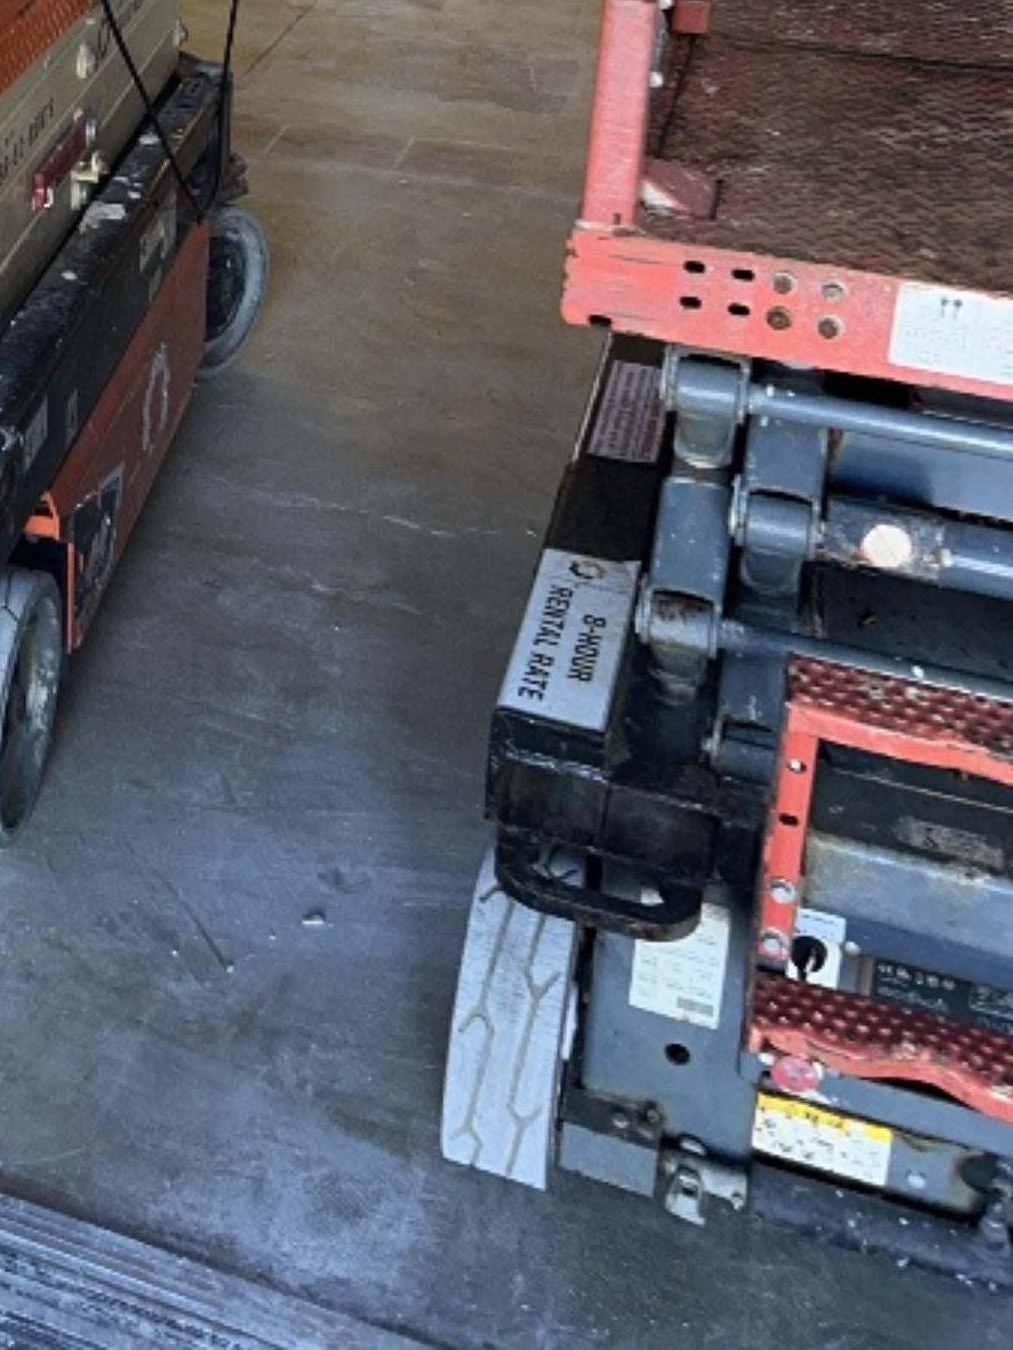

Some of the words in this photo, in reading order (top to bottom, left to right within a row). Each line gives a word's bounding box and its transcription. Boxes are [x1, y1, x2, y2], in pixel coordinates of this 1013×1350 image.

[533, 585, 574, 646] RENTAL
[518, 651, 554, 701] RATE
[567, 614, 607, 682] 8-HOUR
